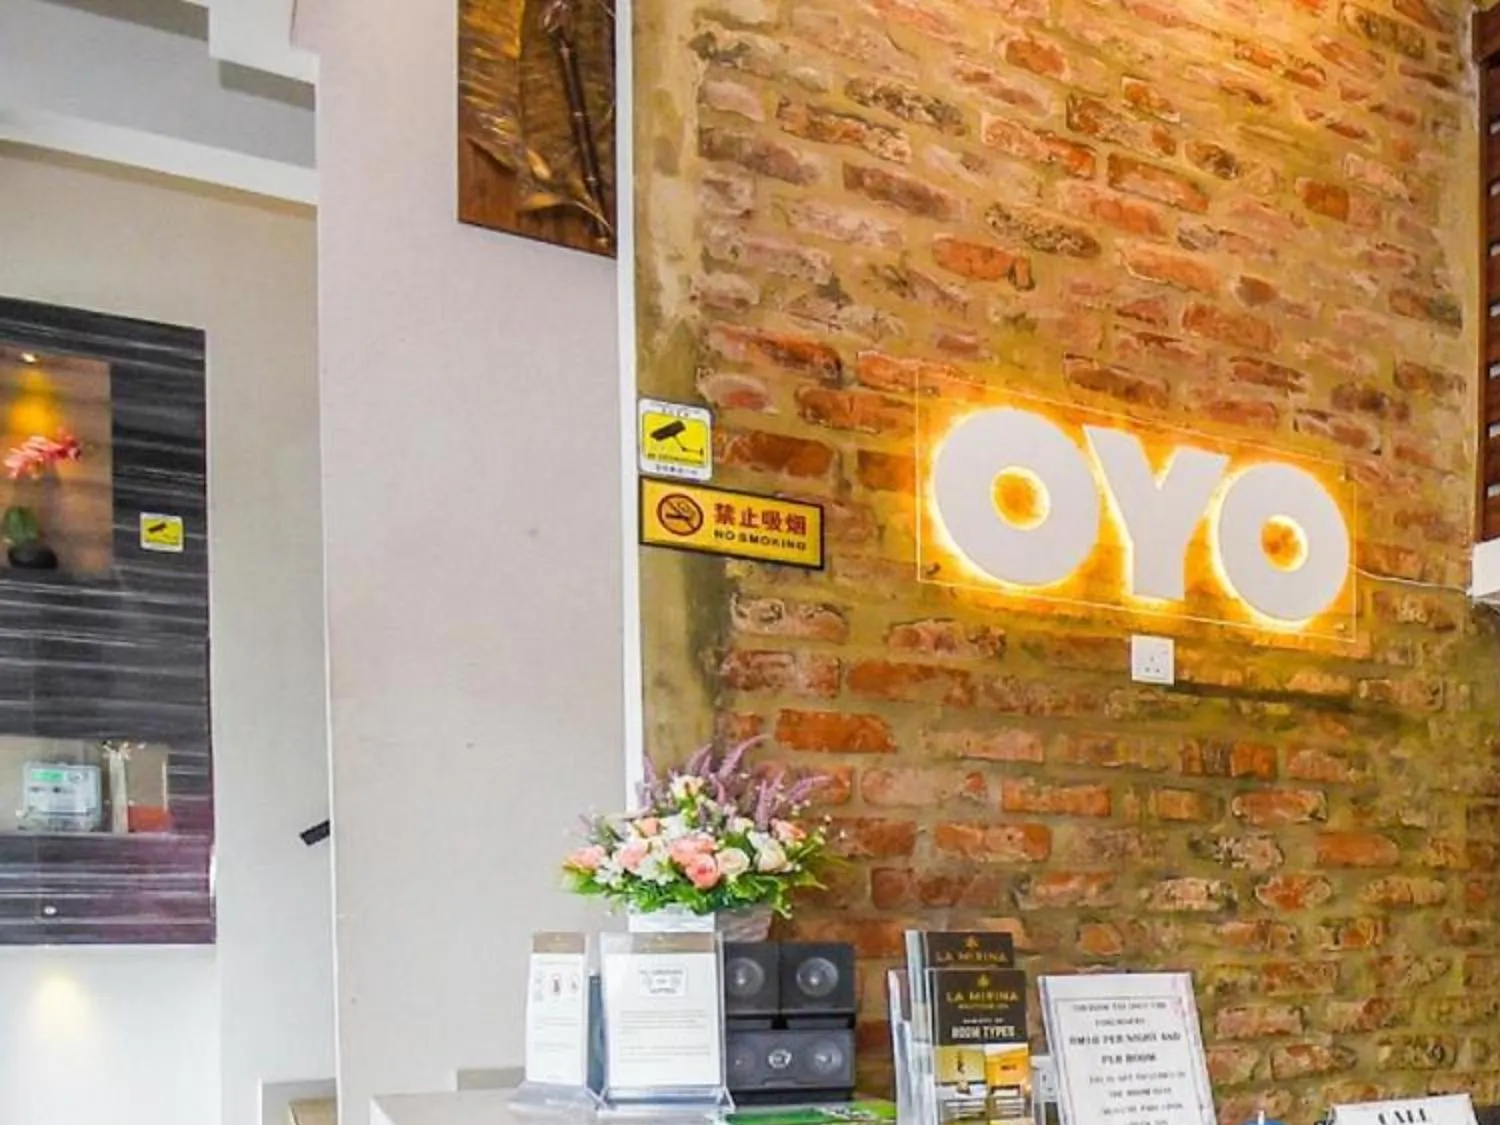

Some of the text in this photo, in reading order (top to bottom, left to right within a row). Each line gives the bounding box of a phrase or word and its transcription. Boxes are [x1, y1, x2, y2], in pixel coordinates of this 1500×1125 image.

[713, 502, 807, 536] 禁止吸烟
[931, 406, 1352, 624] OYO
[713, 528, 807, 551] NO SMOKING
[1102, 1033, 1123, 1045] PER
[1161, 1030, 1182, 1042] AND
[1101, 1054, 1123, 1065] PER
